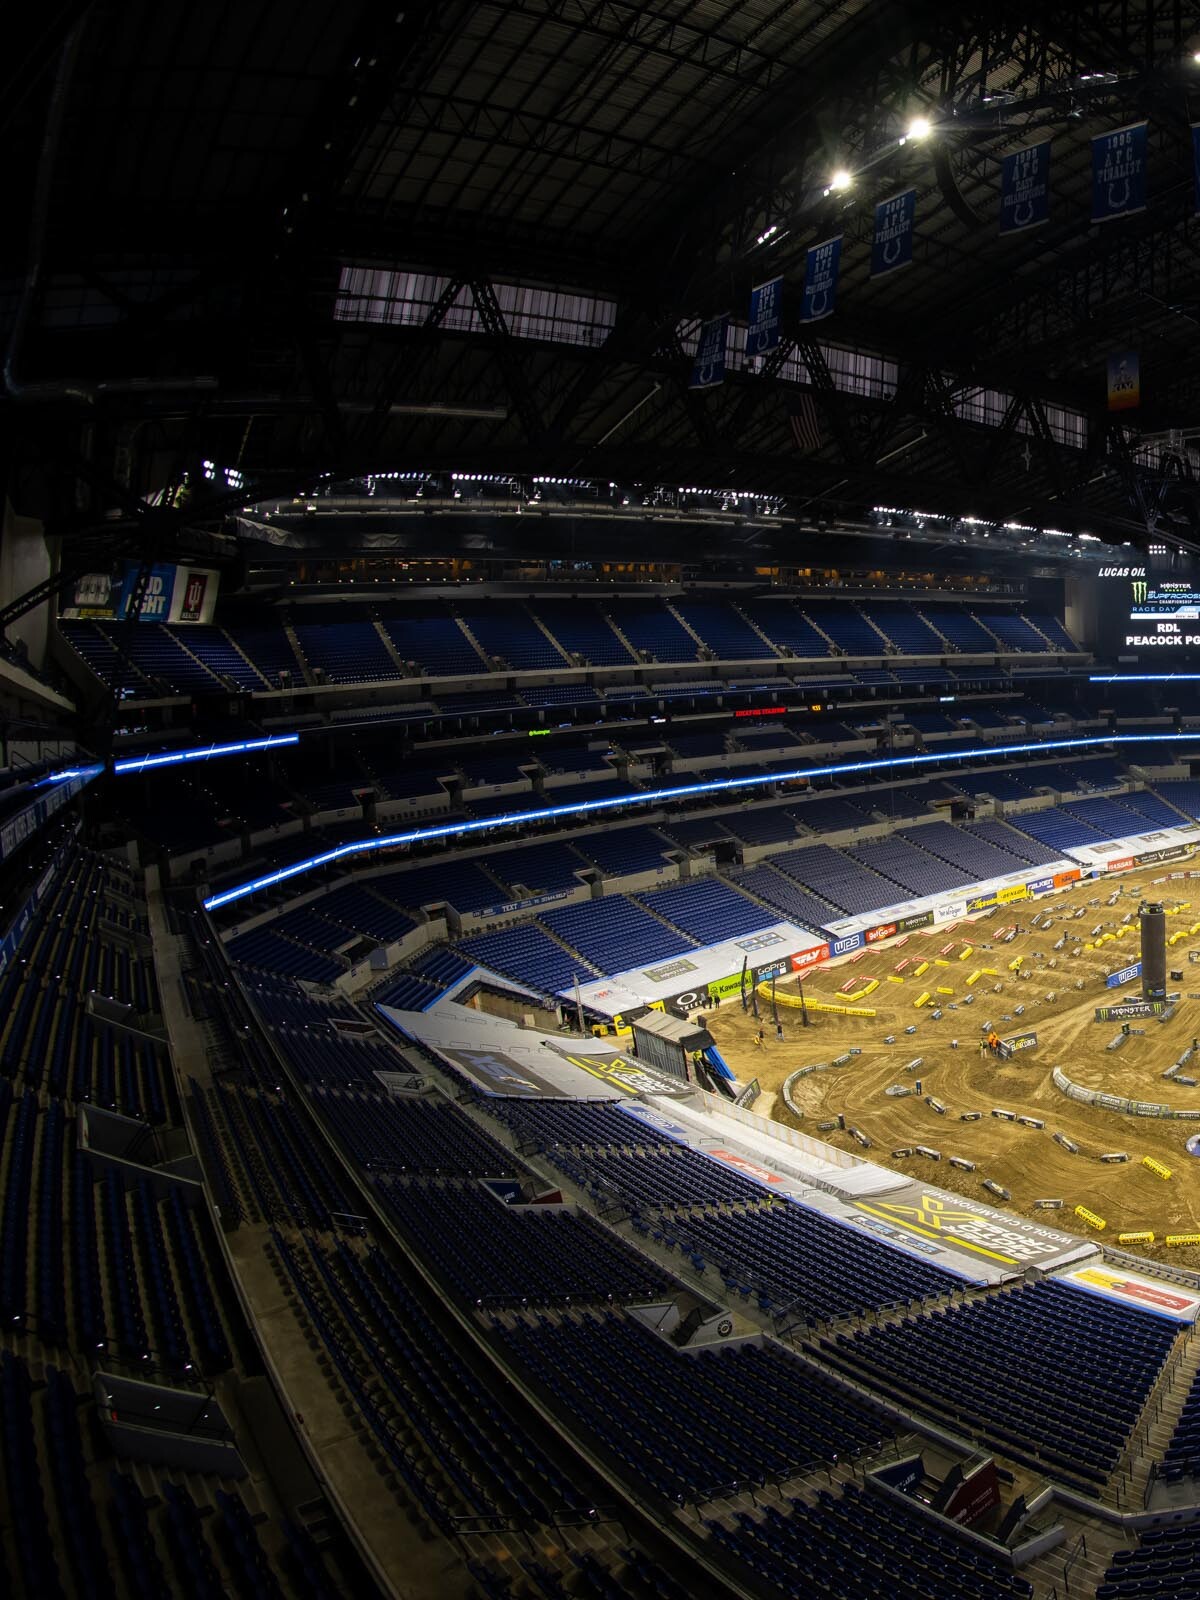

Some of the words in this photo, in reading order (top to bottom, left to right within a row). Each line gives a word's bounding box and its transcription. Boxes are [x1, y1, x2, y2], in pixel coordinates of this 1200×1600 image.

[1098, 567, 1130, 577] LUCAS
[1131, 567, 1146, 576] OIL
[1157, 623, 1180, 633] RDL
[1126, 636, 1182, 645] PEACOCK
[1028, 879, 1053, 890] FALKEN
[1002, 889, 1025, 899] DUNLOP
[905, 915, 928, 926] MONSTER
[834, 935, 860, 954] WPS
[793, 950, 821, 966] FLY
[757, 960, 786, 977] GoPro
[1119, 966, 1138, 984] WPS
[1111, 1004, 1151, 1016] MONSTER
[922, 1189, 1021, 1227] CHAMPIONSHIP
[967, 1219, 1061, 1253] CROSS
[1020, 1224, 1073, 1245] WORLD
[1169, 1240, 1200, 1248] SUZUKI
